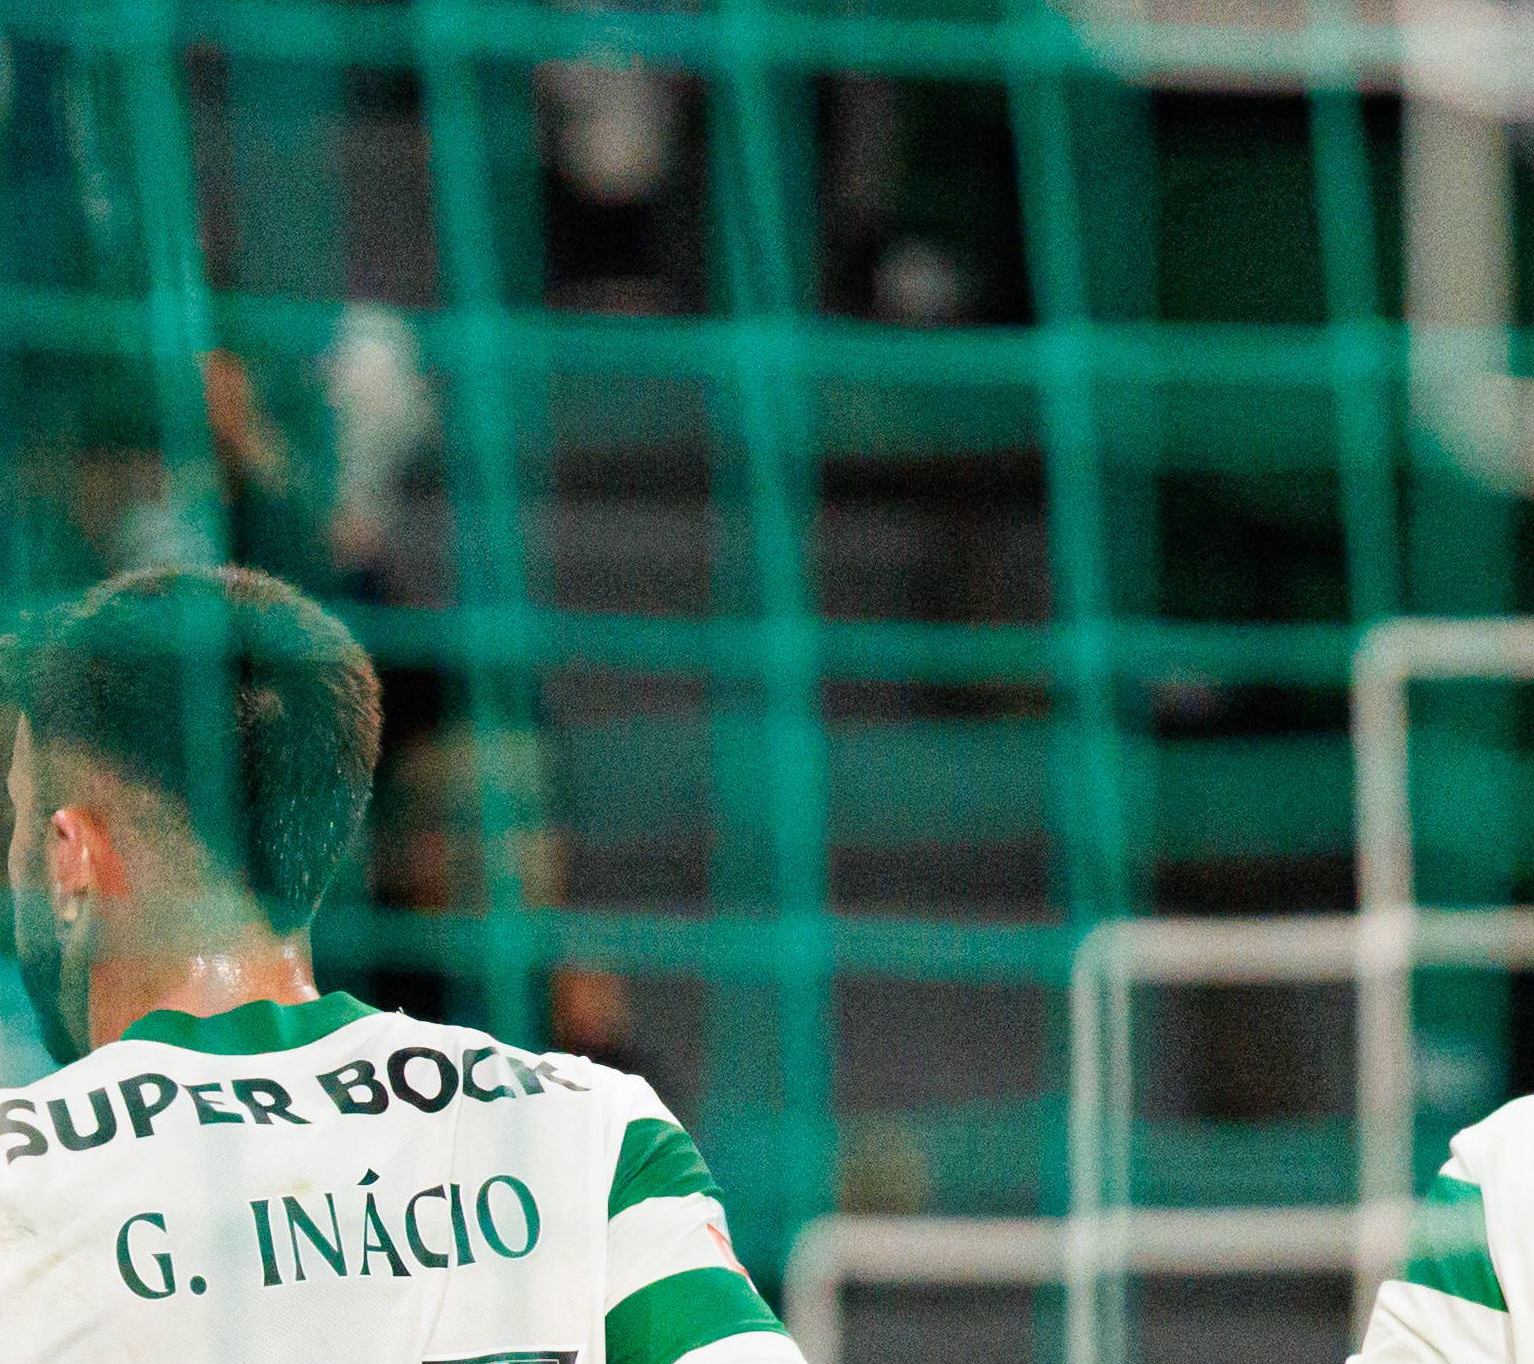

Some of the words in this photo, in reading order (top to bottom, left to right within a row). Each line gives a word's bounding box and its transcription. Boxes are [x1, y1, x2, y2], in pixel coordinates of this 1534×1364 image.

[314, 1044, 593, 1117] BOCK
[115, 1211, 208, 1300] G.
[249, 1167, 542, 1287] INÁCIO
